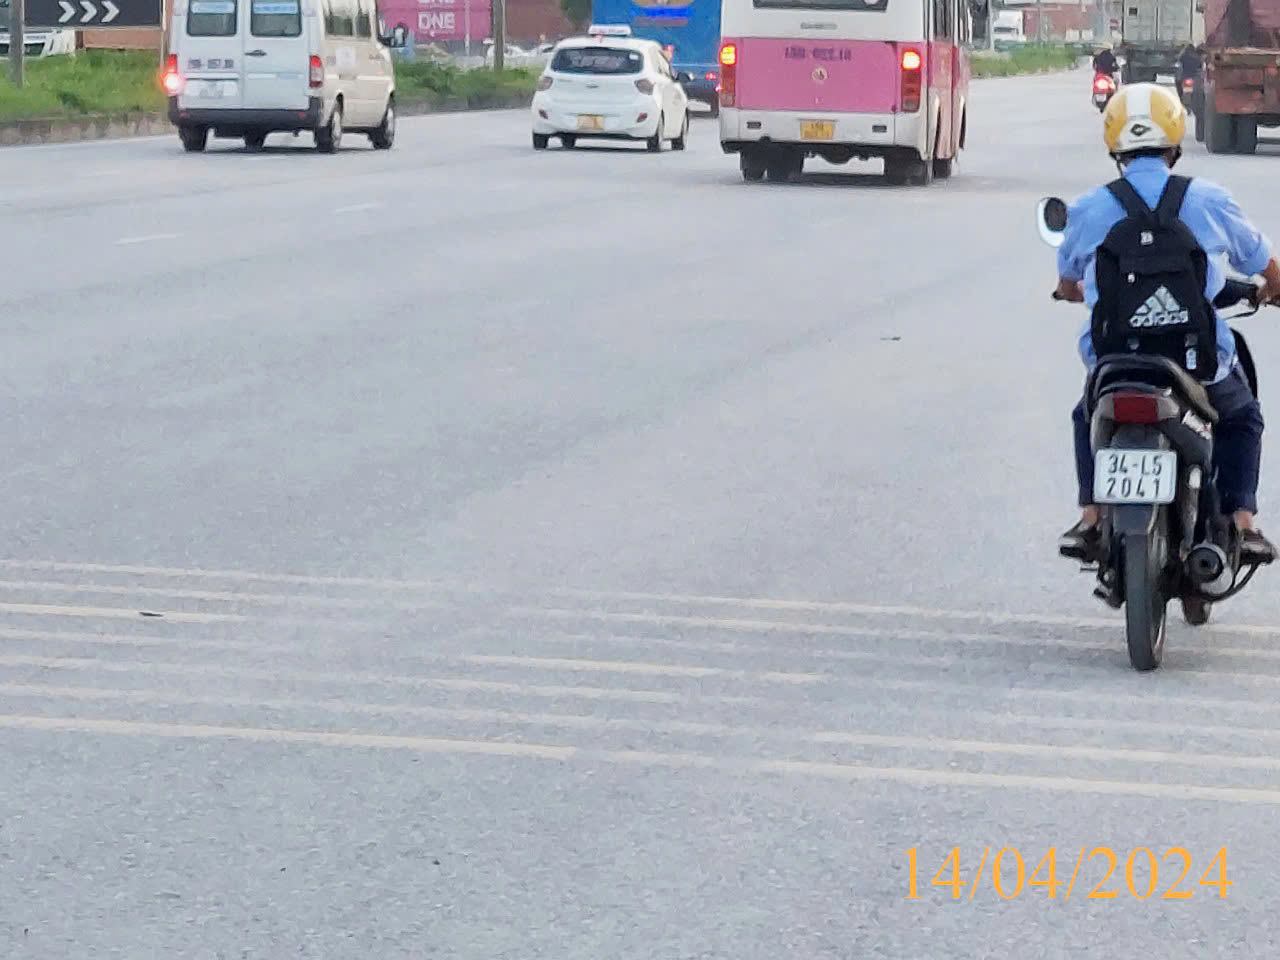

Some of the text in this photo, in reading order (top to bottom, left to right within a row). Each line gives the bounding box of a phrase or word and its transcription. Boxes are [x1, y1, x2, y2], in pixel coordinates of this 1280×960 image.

[418, 11, 455, 30] ONE
[1108, 455, 1162, 478] 34-L5
[1106, 476, 1161, 498] 2041
